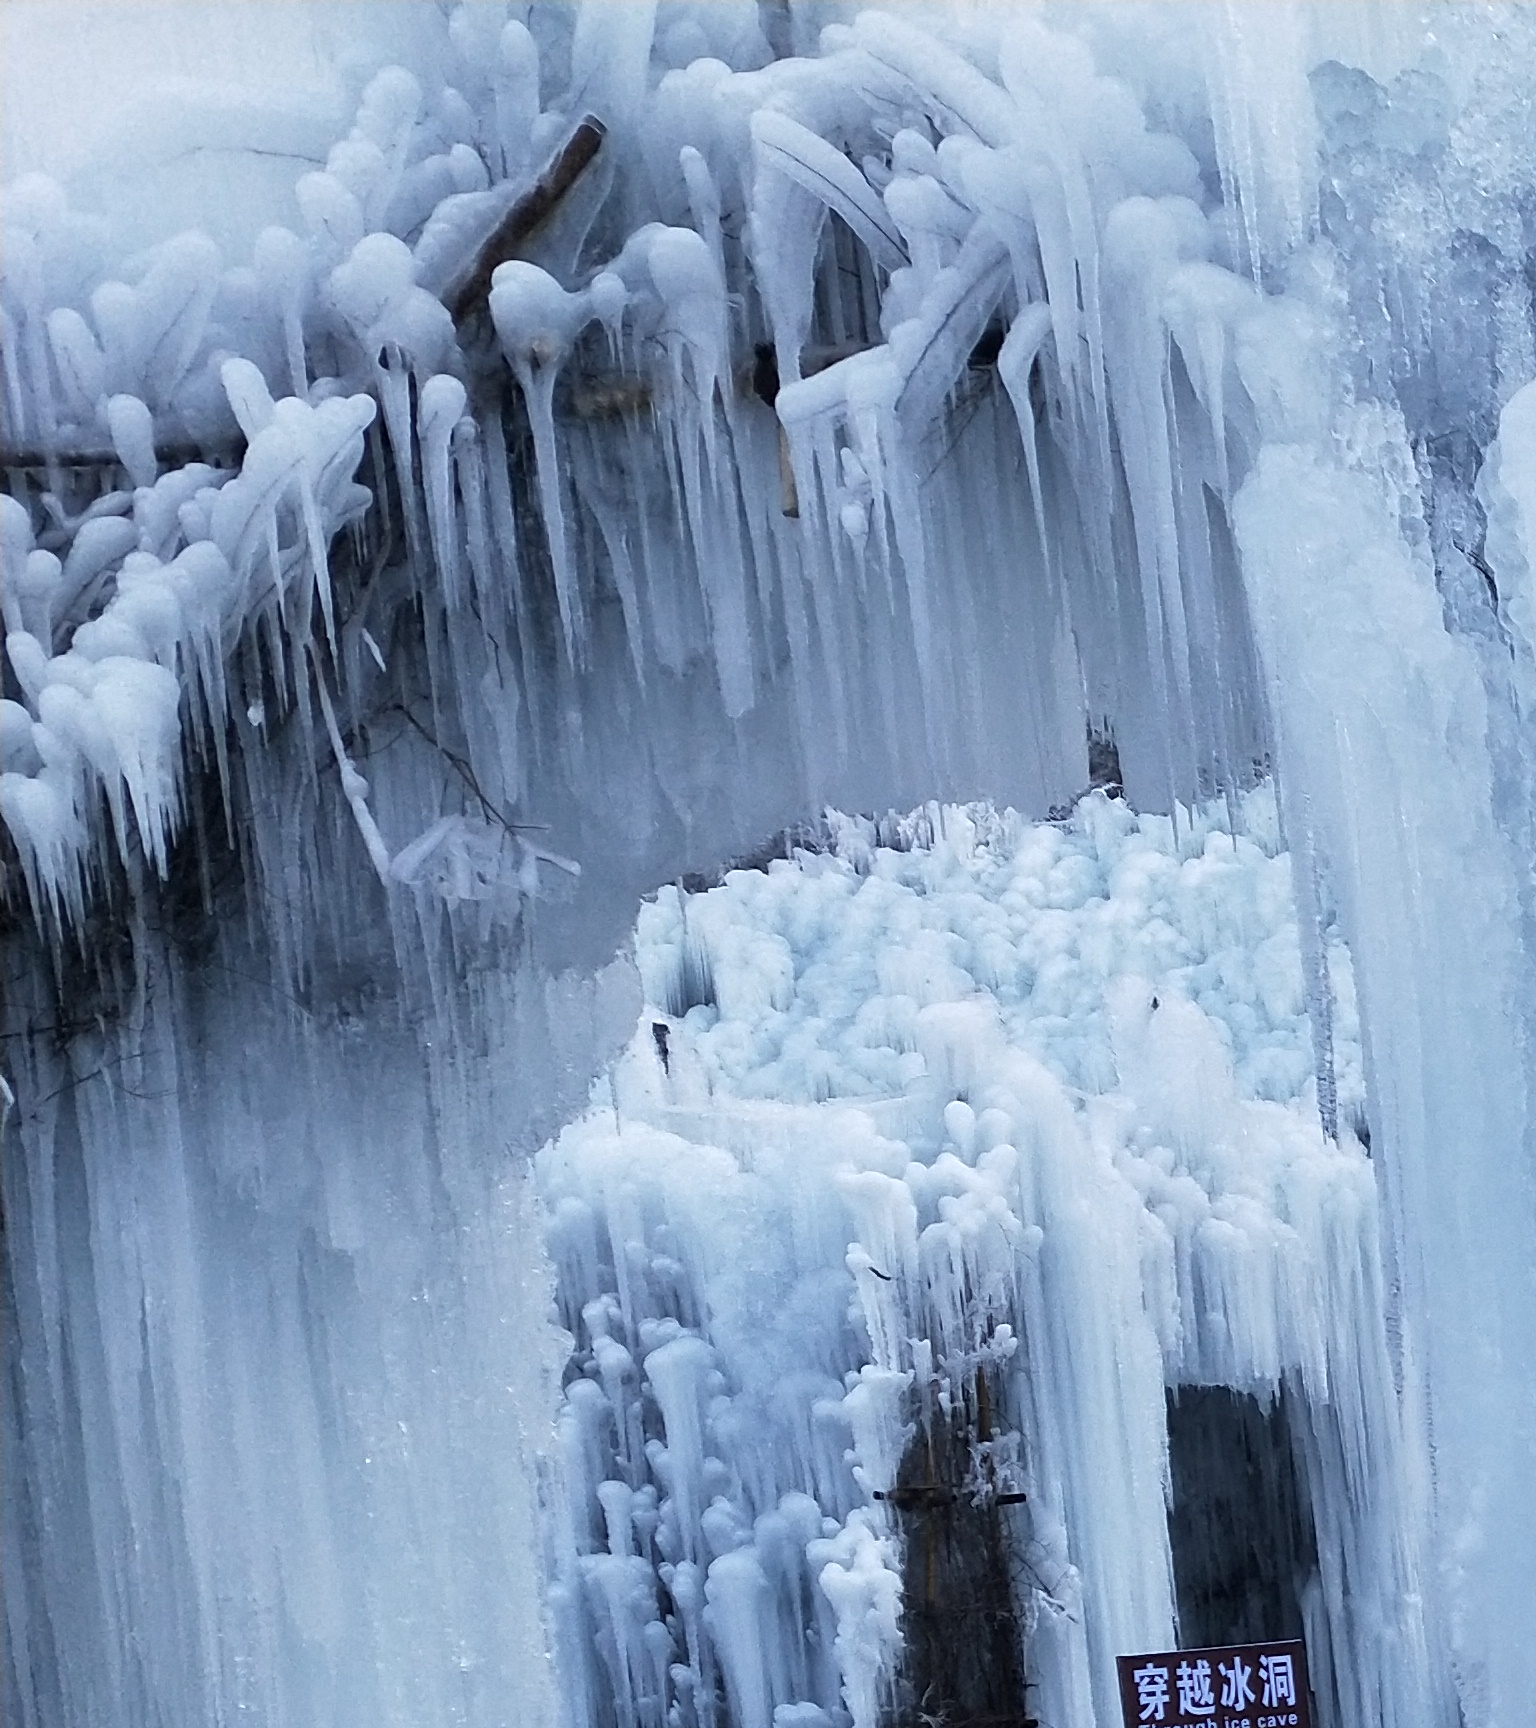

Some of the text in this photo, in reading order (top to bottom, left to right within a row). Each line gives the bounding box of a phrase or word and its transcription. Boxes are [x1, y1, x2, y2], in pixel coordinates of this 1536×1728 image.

[1133, 1654, 1296, 1721] 穿越冰洞
[1257, 1712, 1298, 1728] cave
